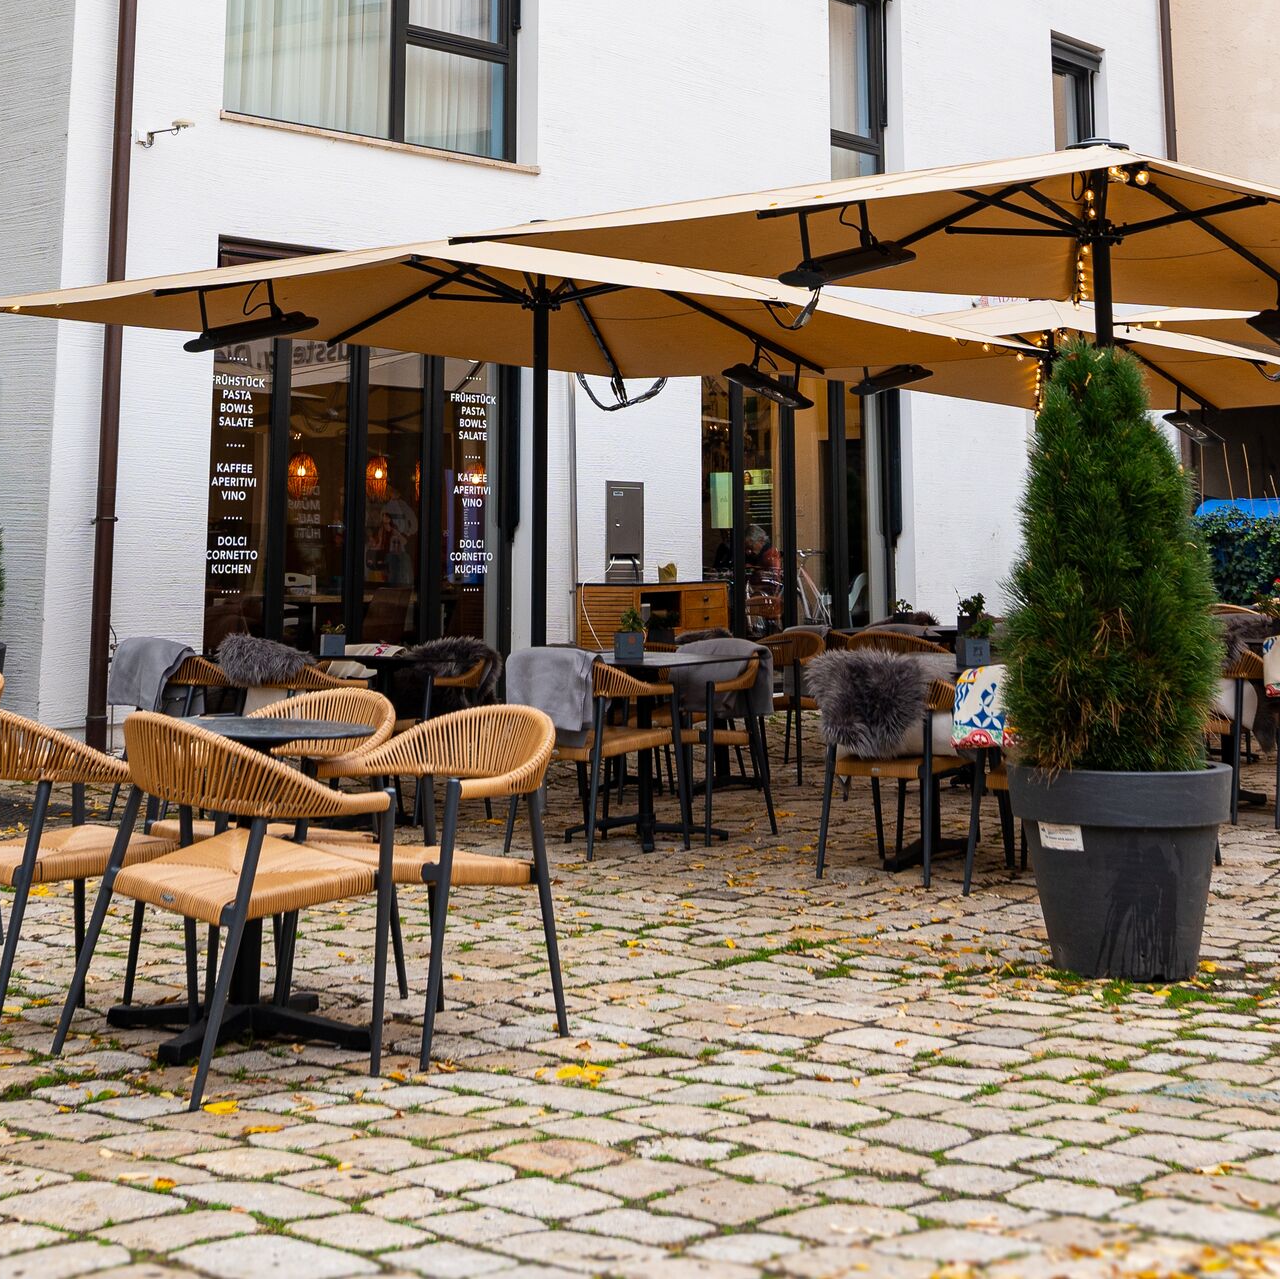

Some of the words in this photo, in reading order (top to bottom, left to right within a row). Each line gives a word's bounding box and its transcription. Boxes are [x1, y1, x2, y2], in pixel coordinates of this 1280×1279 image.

[222, 389, 252, 401] PASTA
[450, 392, 497, 405] FRÜHSTÜCK
[220, 403, 254, 415] BOWLS
[461, 406, 486, 417] PASTA
[219, 416, 254, 428] SALATE
[459, 418, 487, 429] BOWLS
[458, 431, 488, 442] SALATE
[216, 463, 253, 474] KAFFEE
[211, 477, 257, 488] APERITIVI
[221, 490, 246, 501] VINO
[453, 485, 492, 496] APERITIVI
[461, 498, 483, 508] VINO
[217, 536, 247, 547] DOLCI
[459, 539, 484, 549] DOLCI
[206, 550, 258, 561] CORNETTO
[450, 552, 493, 562] CORNETTO
[211, 564, 252, 575] KUCHEN
[454, 564, 488, 574] KUCHEN
